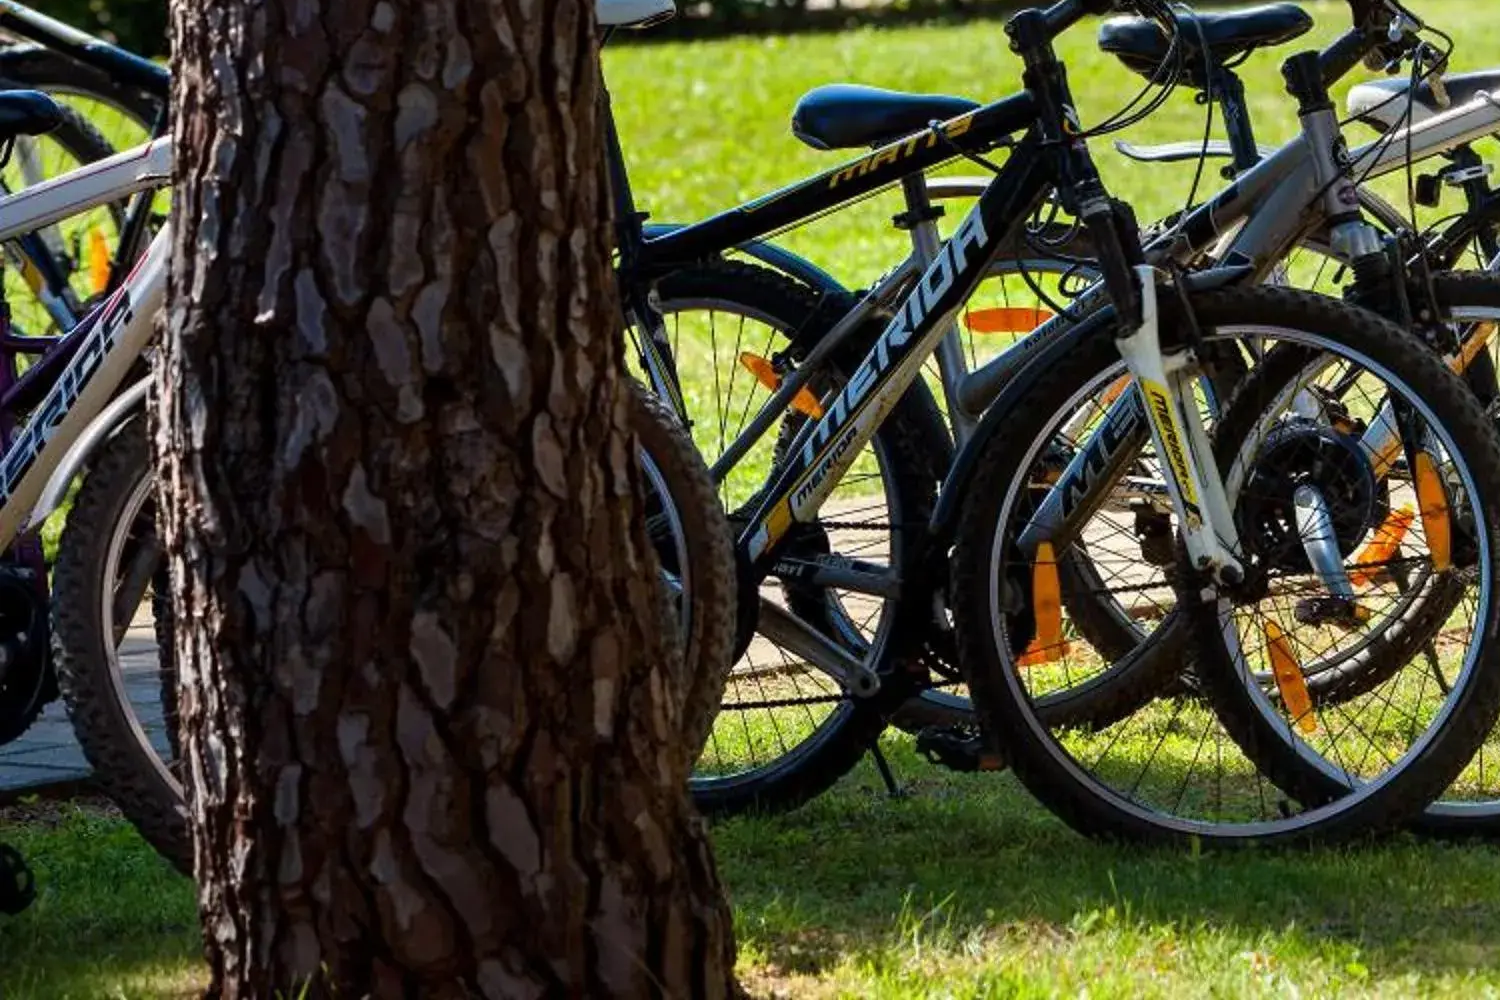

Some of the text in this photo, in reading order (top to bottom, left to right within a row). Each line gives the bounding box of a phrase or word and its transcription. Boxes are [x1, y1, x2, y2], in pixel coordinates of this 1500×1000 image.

[0, 290, 133, 502] ERIDA
[801, 203, 989, 468] MERIDA
[797, 427, 858, 507] MERIDA
